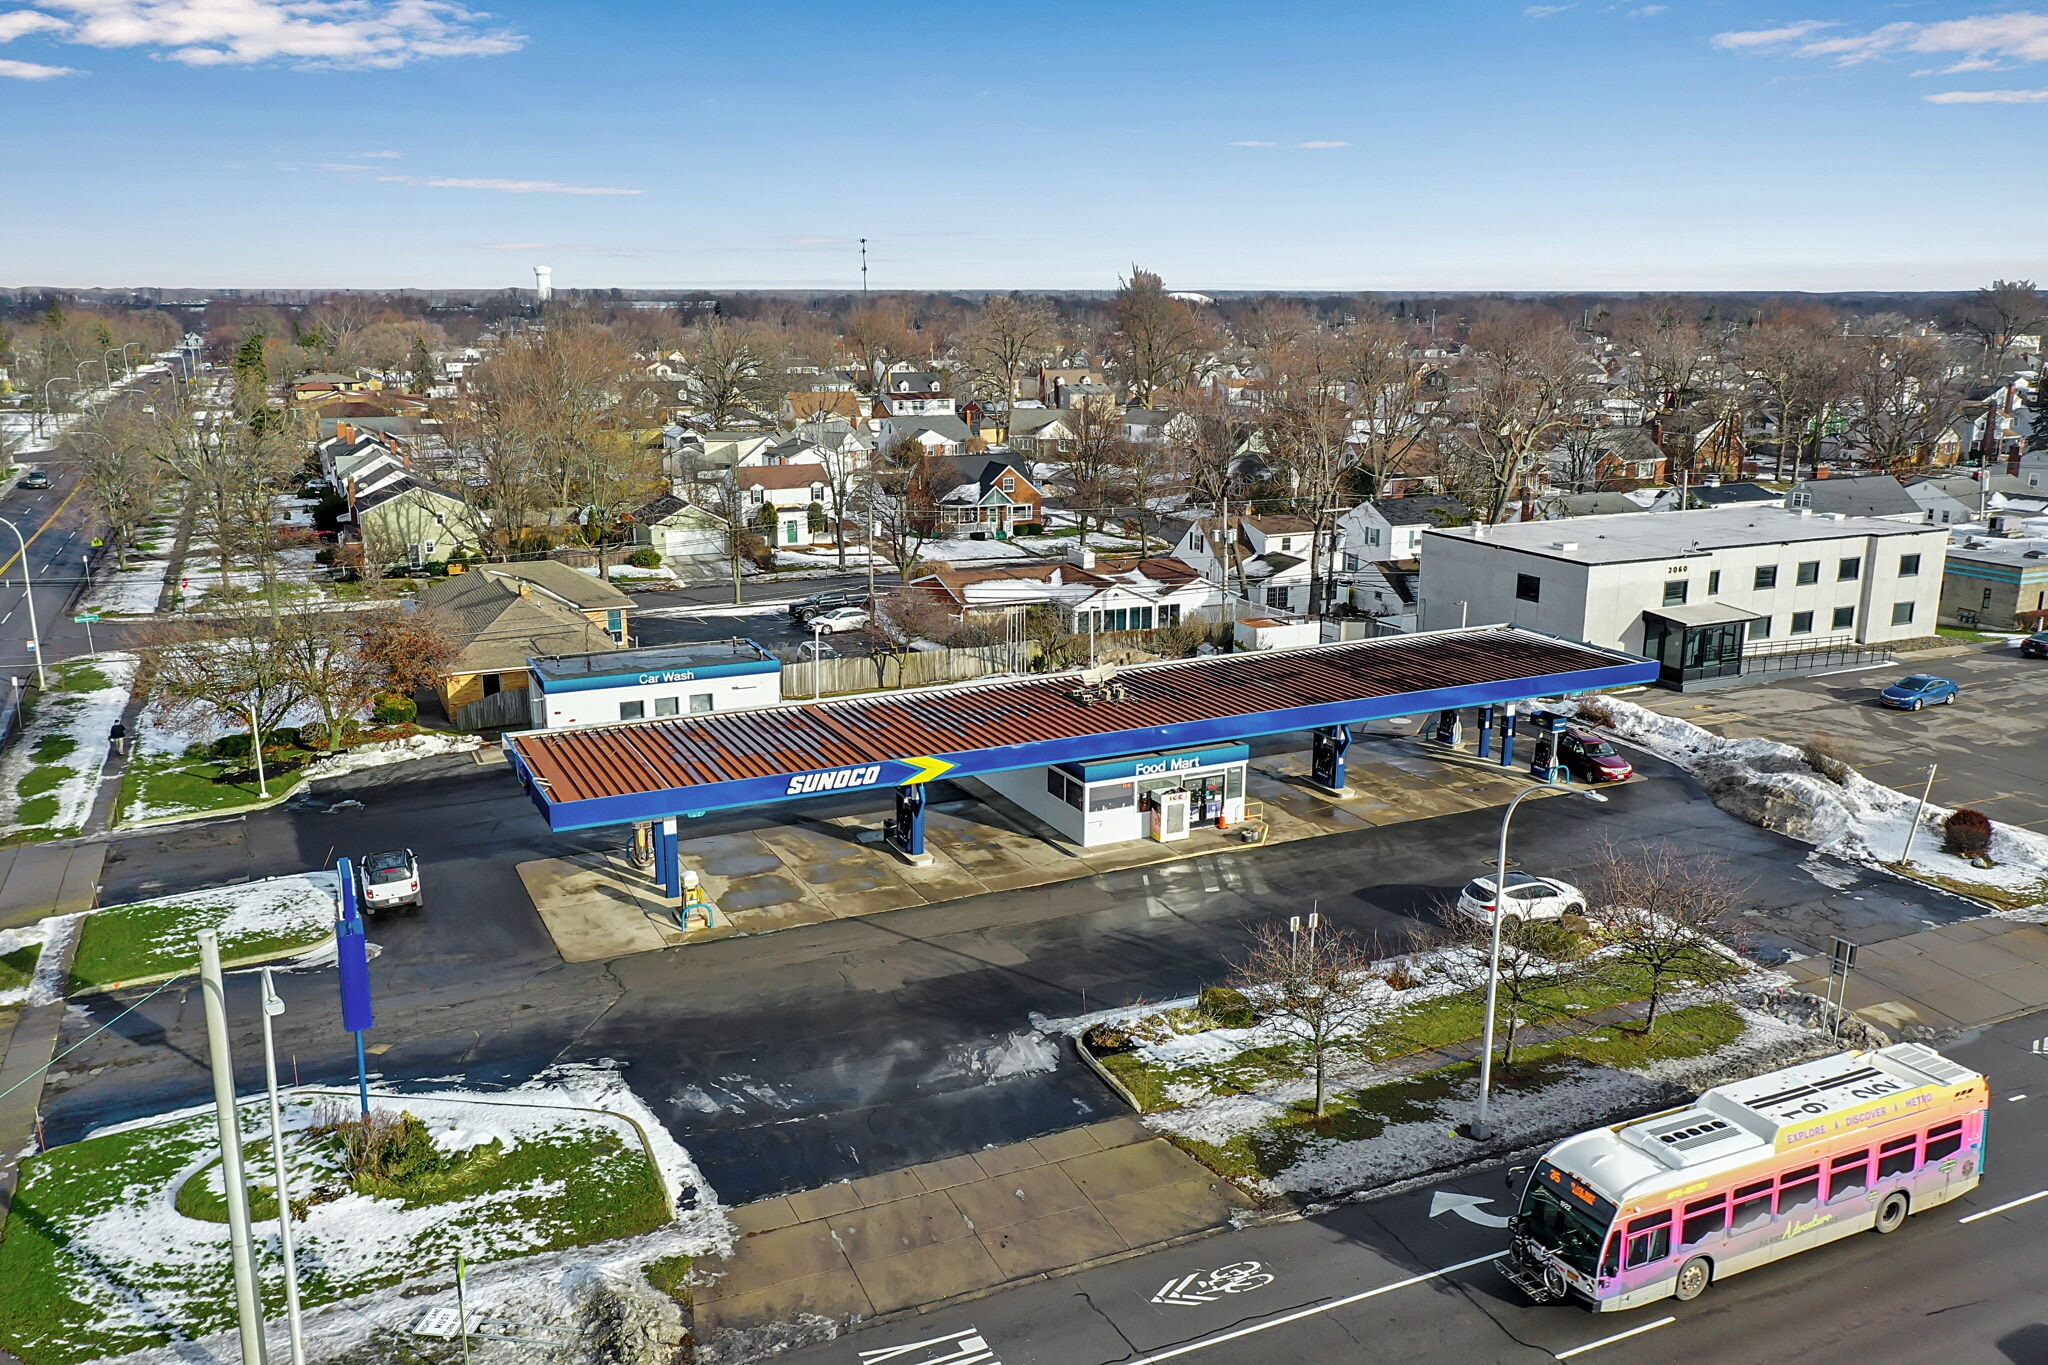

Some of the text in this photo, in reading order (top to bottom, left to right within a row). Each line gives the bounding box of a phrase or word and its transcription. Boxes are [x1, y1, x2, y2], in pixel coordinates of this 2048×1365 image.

[1667, 565, 1688, 574] 2060
[639, 670, 695, 685] Car Wash
[1135, 756, 1200, 776] Food Mart
[786, 765, 881, 796] SUNOCO
[1787, 1092, 1934, 1145] EXPLORE DISCOVER METRO
[434, 1313, 452, 1329] MUST
